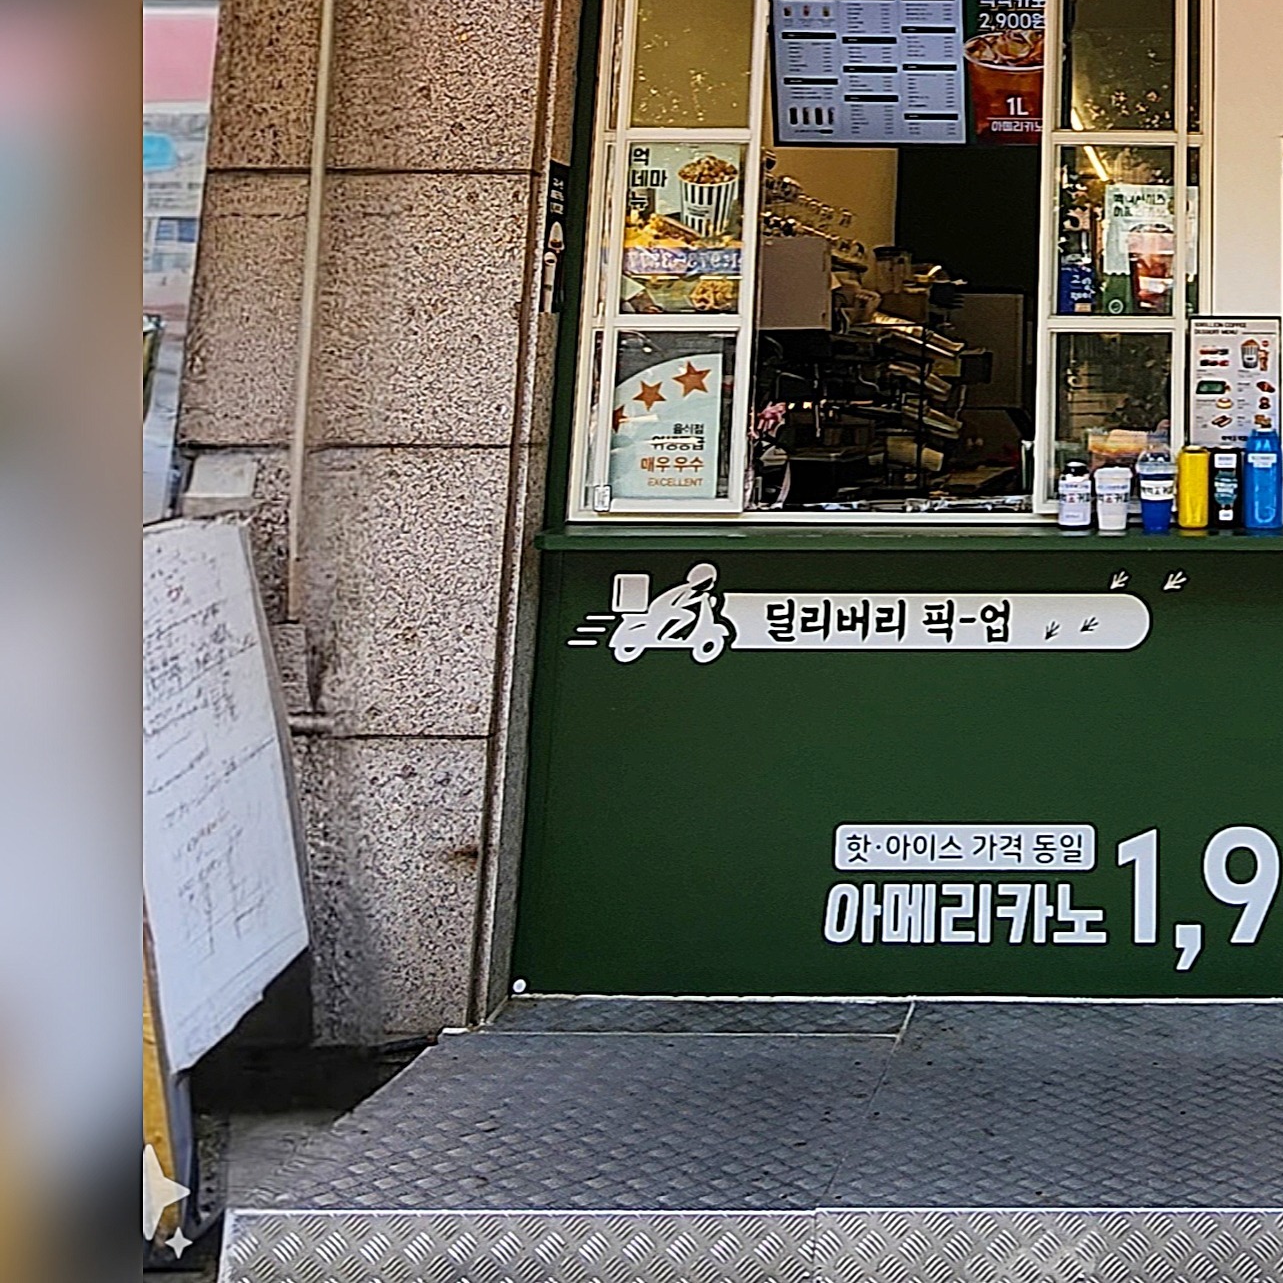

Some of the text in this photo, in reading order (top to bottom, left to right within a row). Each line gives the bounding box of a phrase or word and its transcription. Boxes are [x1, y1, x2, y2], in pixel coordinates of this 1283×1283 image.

[1006, 97, 1029, 116] 1L
[647, 477, 704, 487] EXCELLENT
[766, 599, 1011, 643] 딜리버리 픽-업
[847, 834, 1083, 864] 핫·아이스 가격 동일
[824, 884, 1107, 945] 아메리카노
